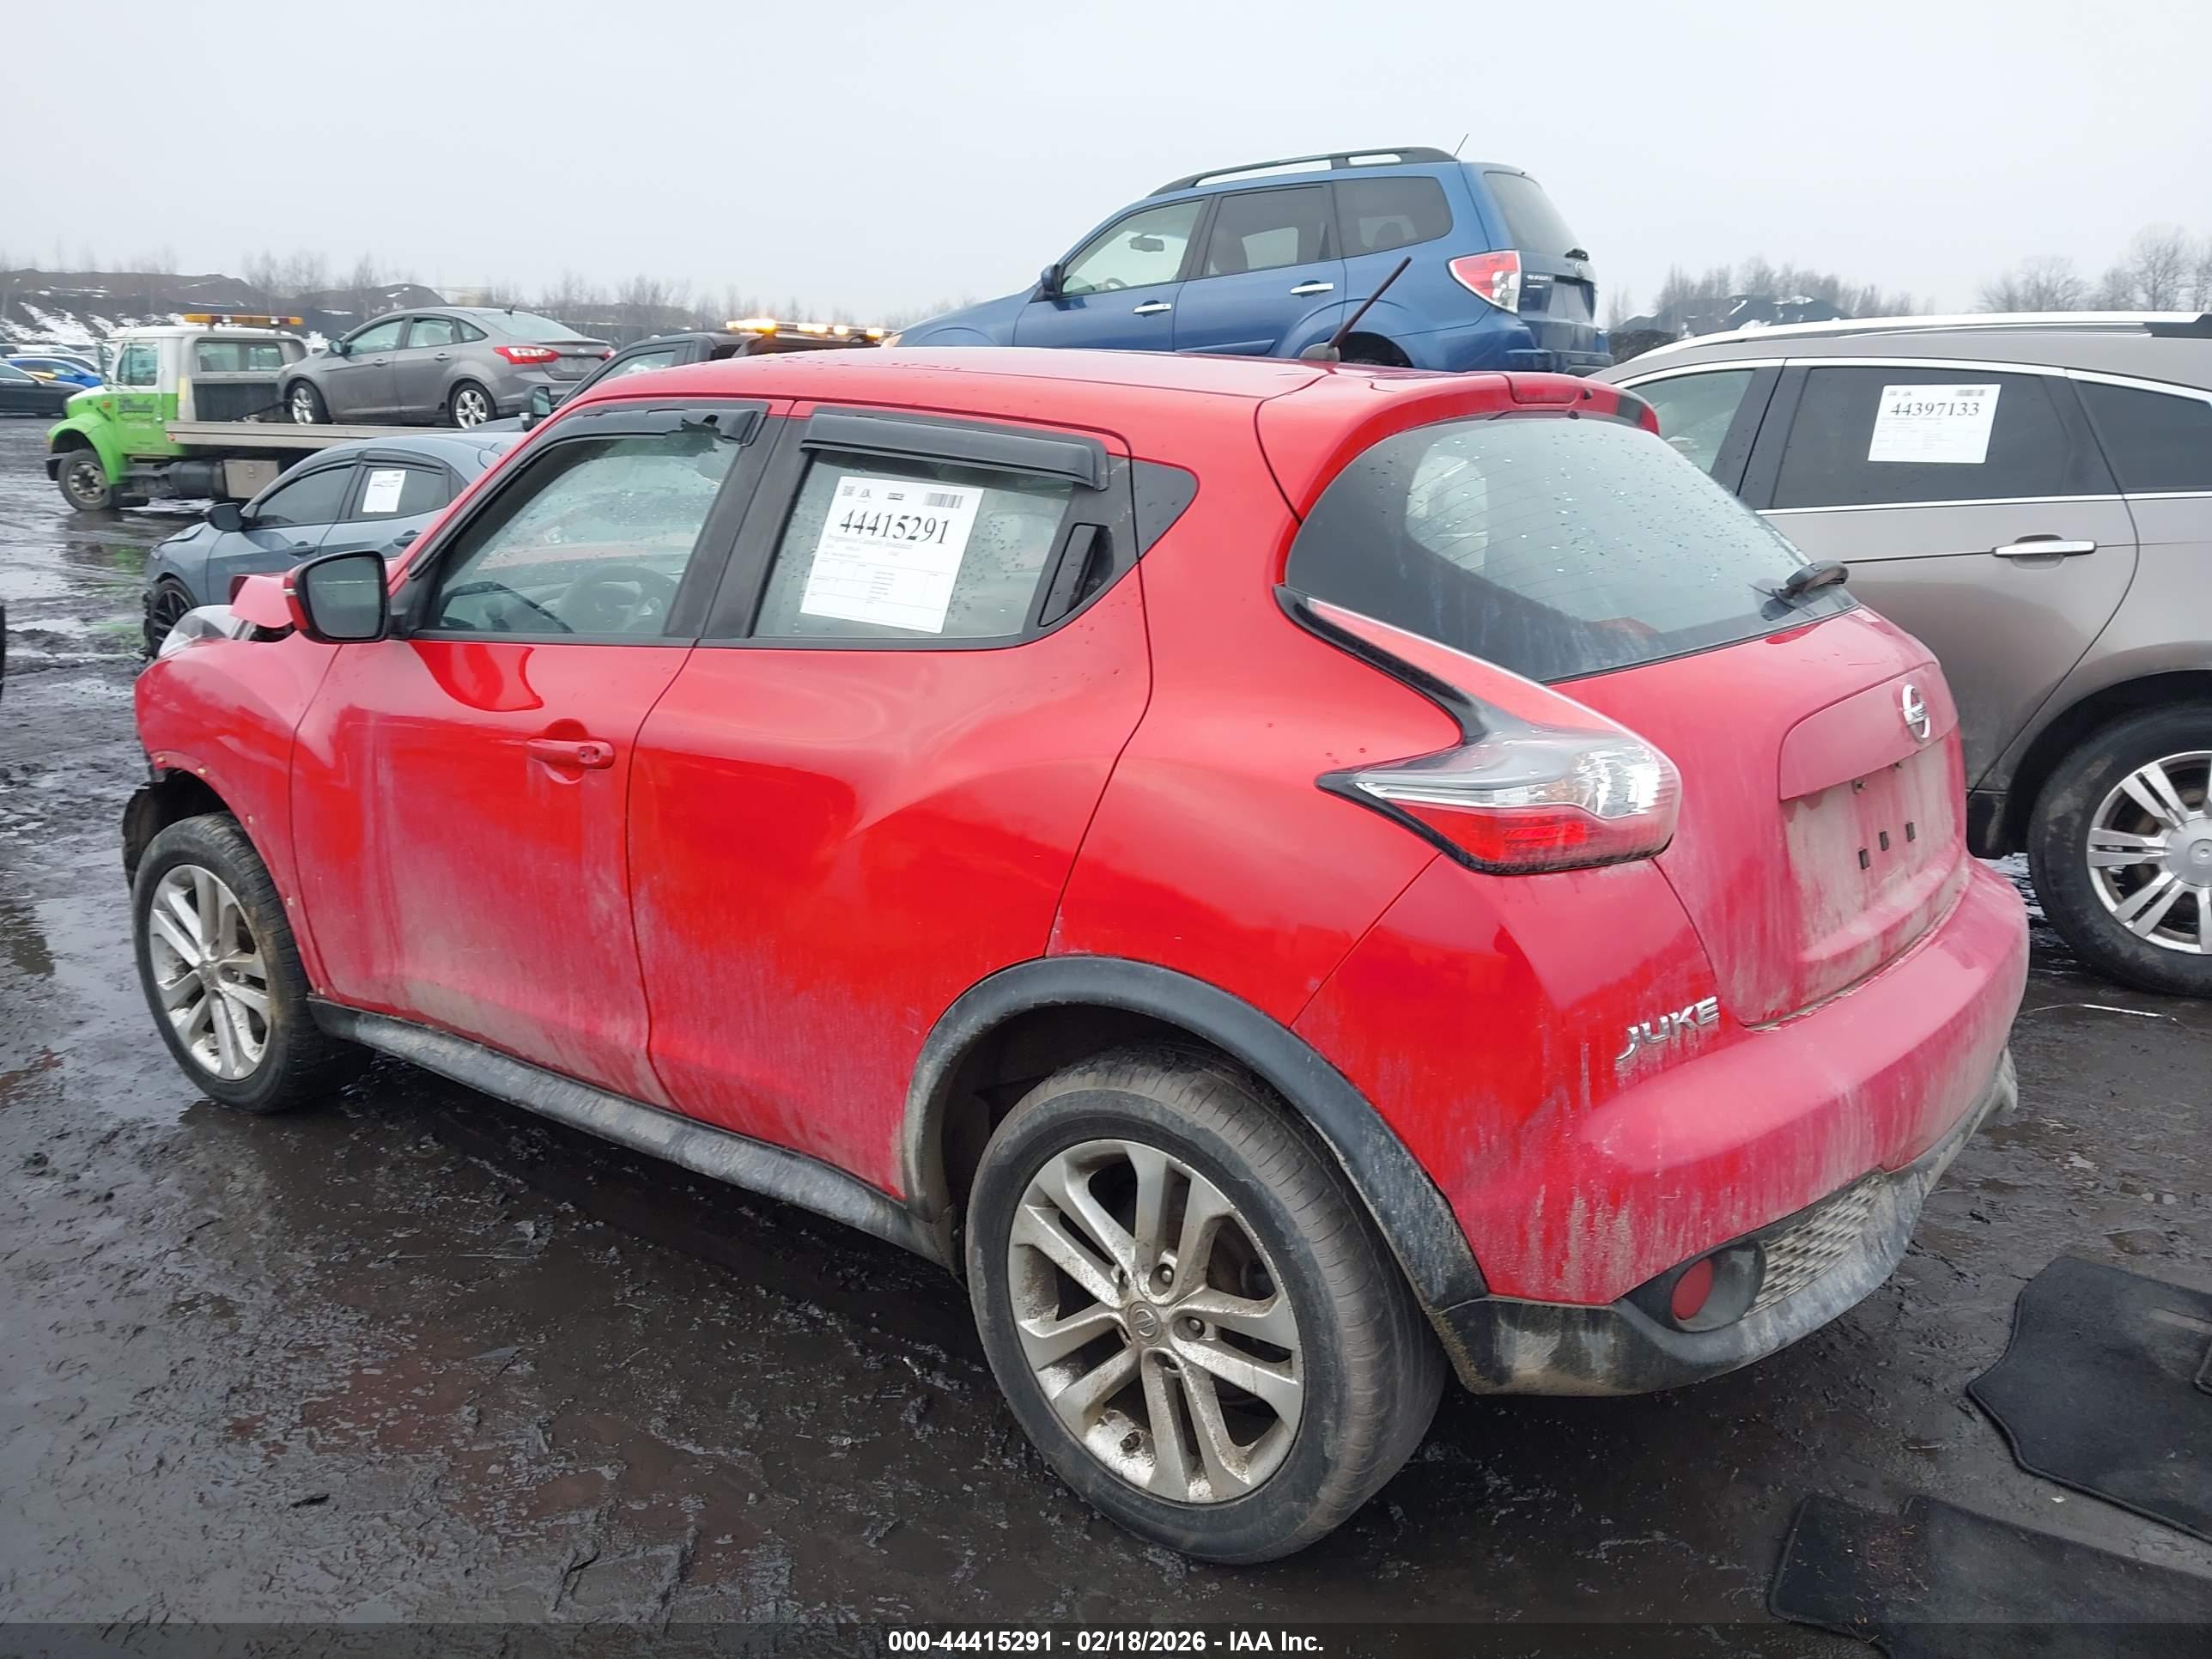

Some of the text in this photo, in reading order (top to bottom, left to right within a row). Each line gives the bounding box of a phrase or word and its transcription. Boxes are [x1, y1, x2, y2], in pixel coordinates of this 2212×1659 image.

[1890, 402, 1980, 416] 44397133
[840, 508, 951, 544] 44415291
[1614, 996, 1720, 1060] JUKE
